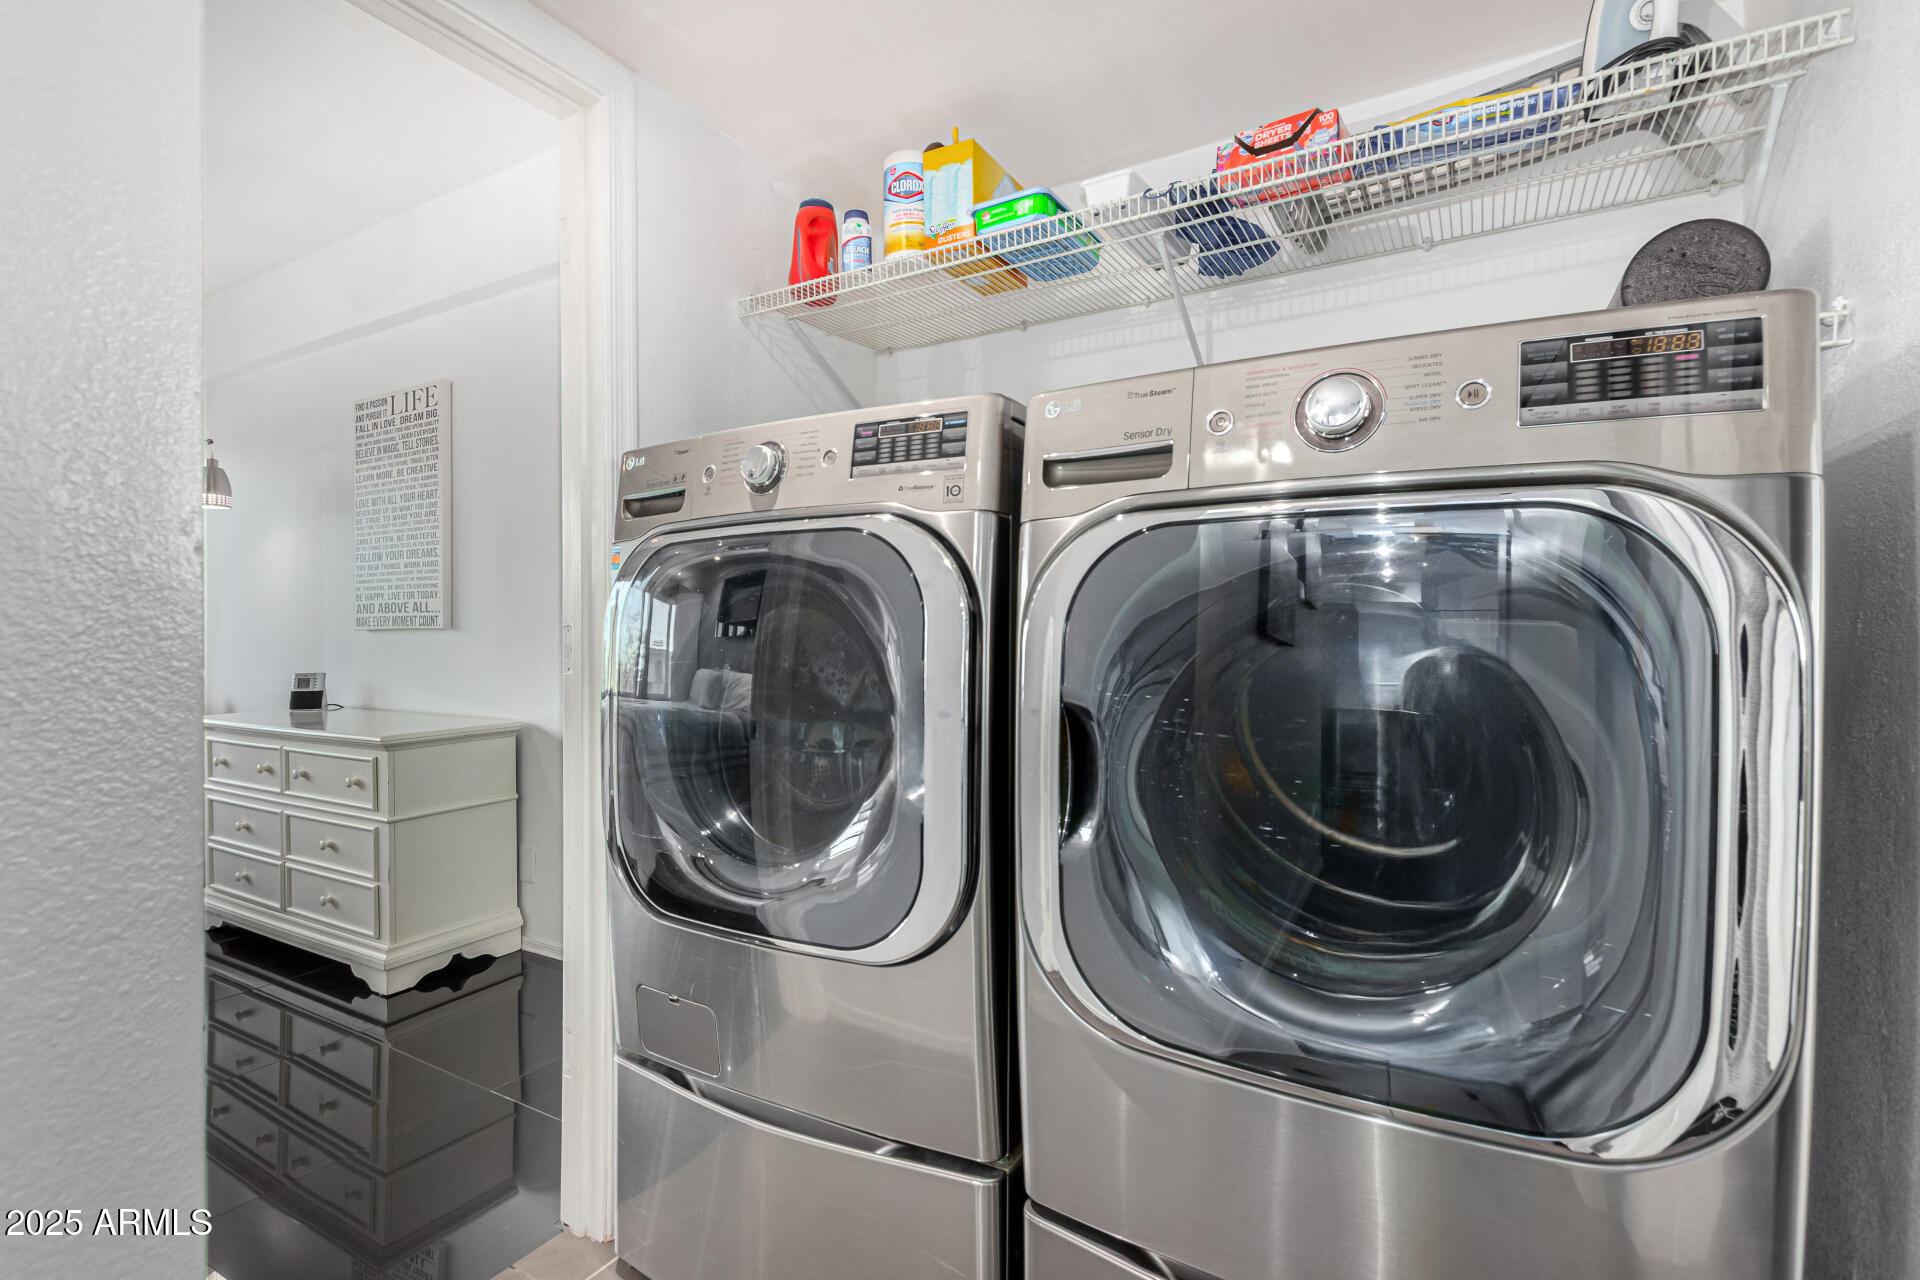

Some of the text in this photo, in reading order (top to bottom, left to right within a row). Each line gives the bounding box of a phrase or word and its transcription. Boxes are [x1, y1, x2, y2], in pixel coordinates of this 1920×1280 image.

[1318, 112, 1334, 123] 100
[1255, 123, 1293, 142] DRYER
[1254, 131, 1293, 149] SHEETS
[891, 180, 924, 194] CLOROX
[937, 230, 972, 244] DUSTERS
[1646, 333, 1701, 353] 18:88
[370, 397, 387, 409] PASSION
[390, 384, 438, 416] LIFE
[1063, 400, 1082, 414] LG
[356, 414, 364, 424] AND
[366, 410, 382, 422] PURSUE
[356, 423, 371, 434] FALL
[372, 421, 378, 431] IN
[400, 411, 424, 425] DREAM
[426, 408, 439, 420] BIG.
[399, 432, 413, 440] LAUGH
[1123, 427, 1173, 440] Sensor Dry
[356, 446, 375, 460] BELIEVE
[377, 445, 382, 456] IN
[402, 439, 414, 451] TELL
[634, 456, 646, 467] LG
[356, 473, 374, 484] LEARN
[397, 468, 405, 477] BE
[946, 484, 962, 497] 10
[356, 498, 371, 509] LOVE
[371, 496, 386, 507] WITH
[388, 494, 398, 505] ALL
[400, 492, 416, 503] YOUR
[392, 513, 408, 522] WHO
[409, 511, 423, 520] YOU
[356, 538, 373, 546] SMILE
[356, 552, 383, 563] FOLLOW
[385, 550, 404, 561] YOUR
[404, 561, 420, 569] WORK
[356, 594, 364, 602] BE
[388, 592, 402, 601] LIVE
[403, 591, 415, 600] FOR
[357, 600, 440, 615] AND ABOVE ALL...
[356, 614, 440, 628] MAKE EVERY MOMENT COUNT.
